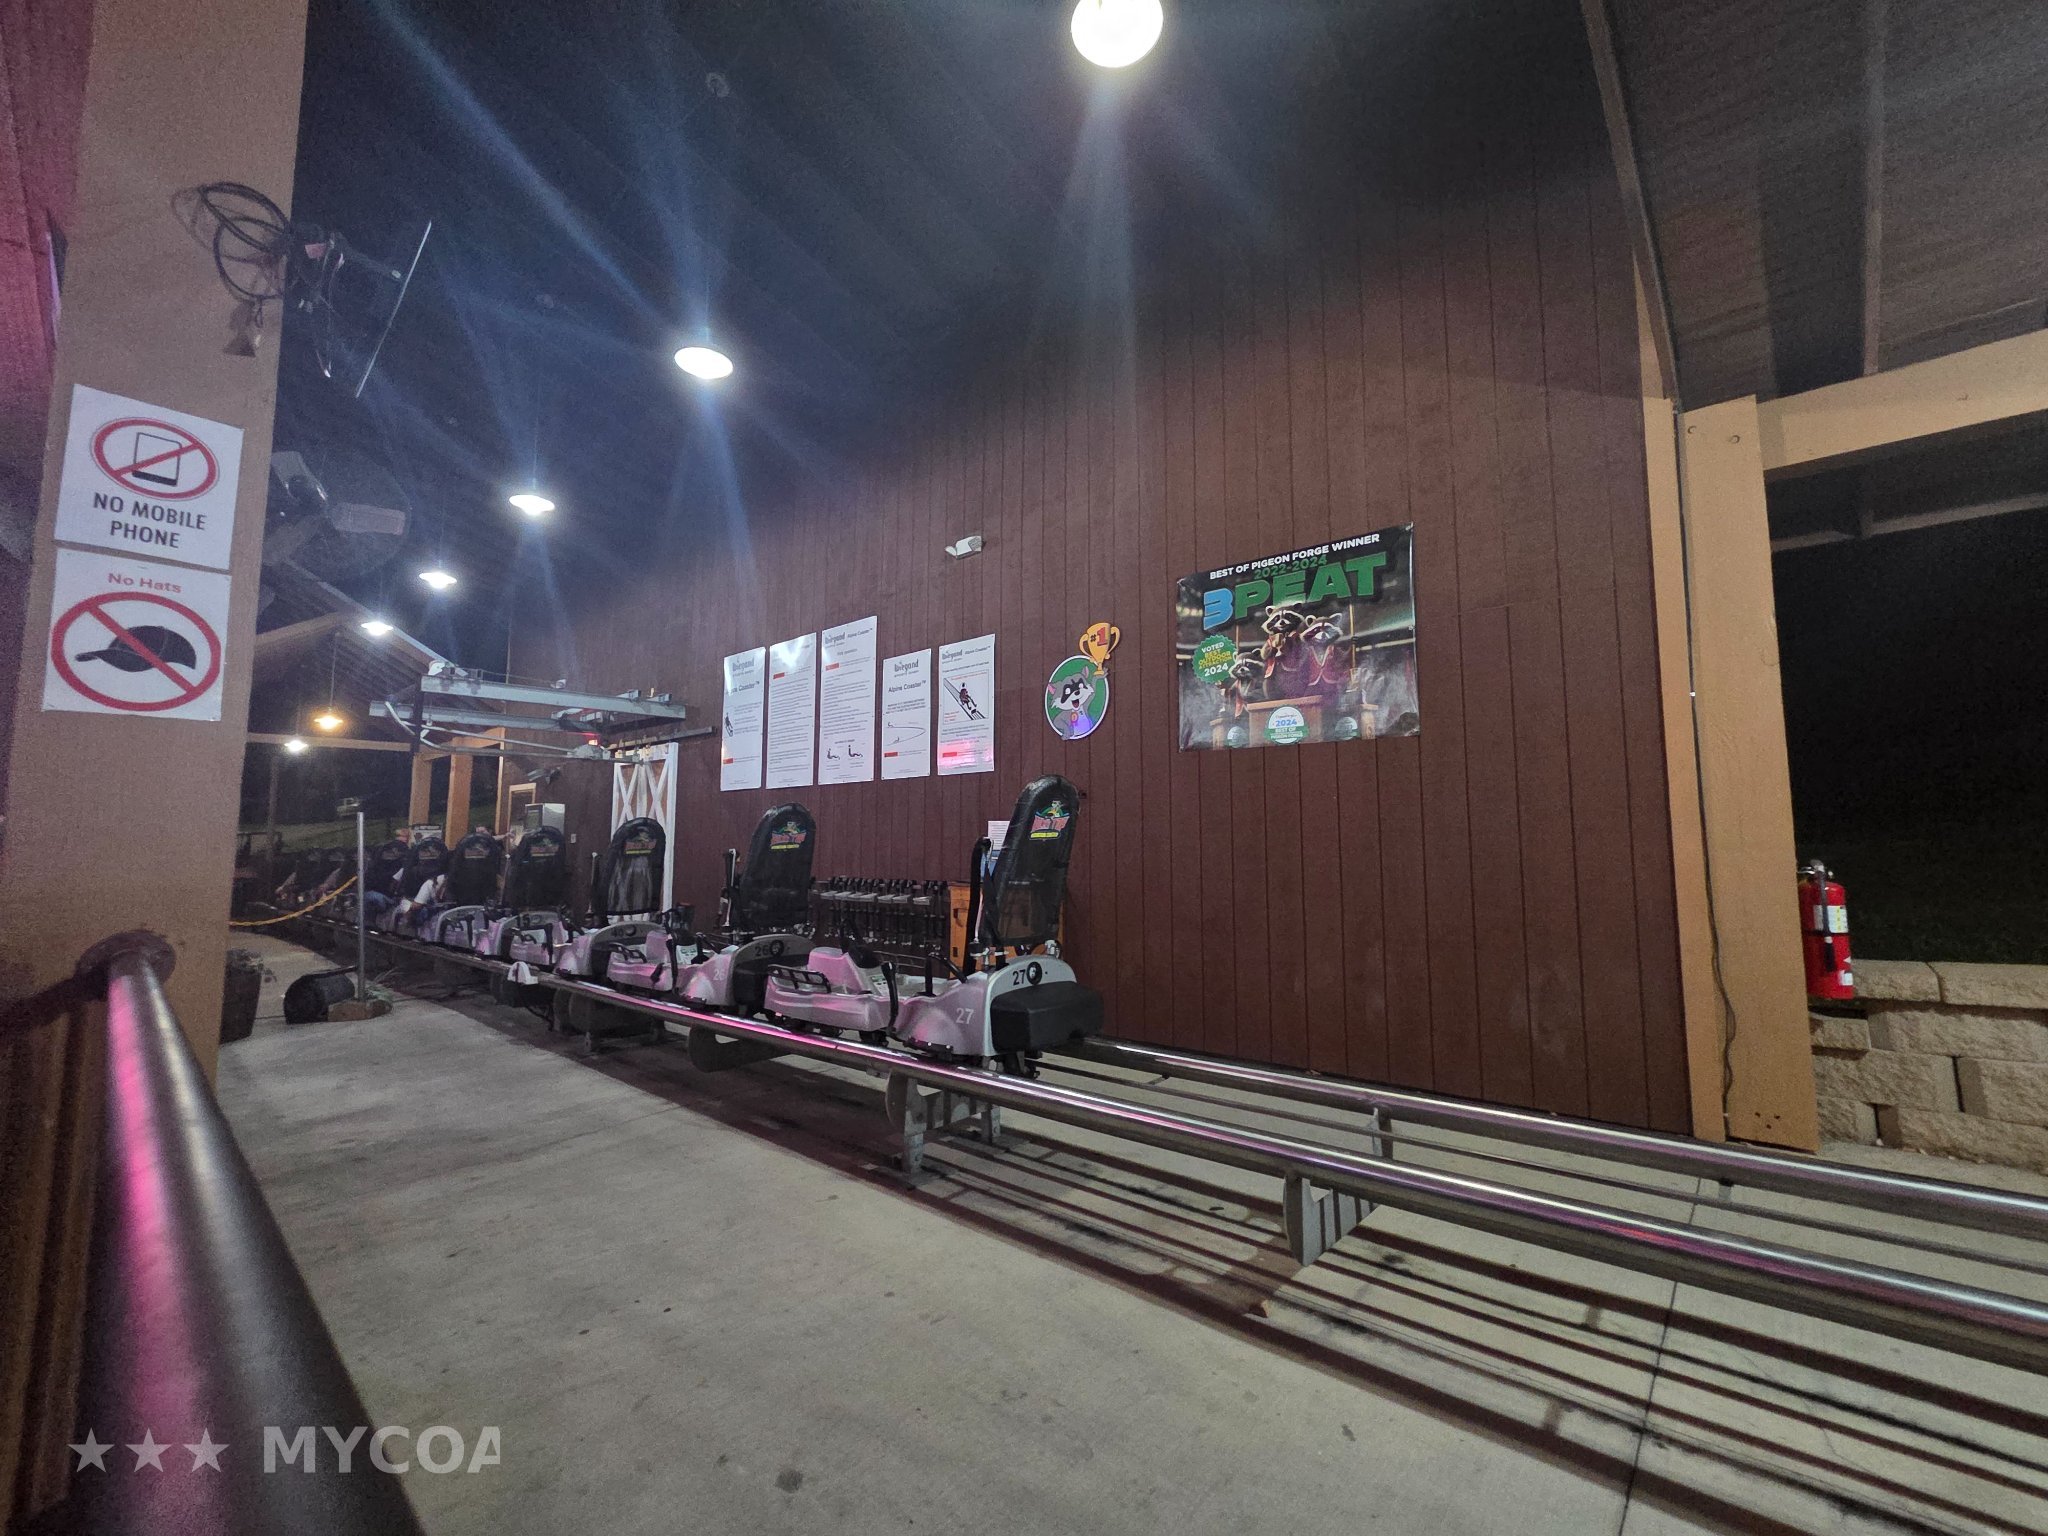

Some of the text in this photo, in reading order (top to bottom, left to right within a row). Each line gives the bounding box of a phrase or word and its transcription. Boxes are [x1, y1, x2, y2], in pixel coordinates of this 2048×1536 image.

[93, 491, 207, 531] NO MOBILE
[110, 520, 180, 549] PHONE
[1210, 533, 1380, 580] BEST OF PIGEON FORGE WINNER
[1254, 554, 1328, 580] 2022-2024
[107, 573, 182, 594] No Hats
[1090, 627, 1108, 646] #1
[1201, 641, 1225, 653] VOTED
[1204, 662, 1228, 677] 2024
[1275, 719, 1297, 727] 2024
[1012, 969, 1026, 986] 27
[956, 1007, 974, 1025] 27
